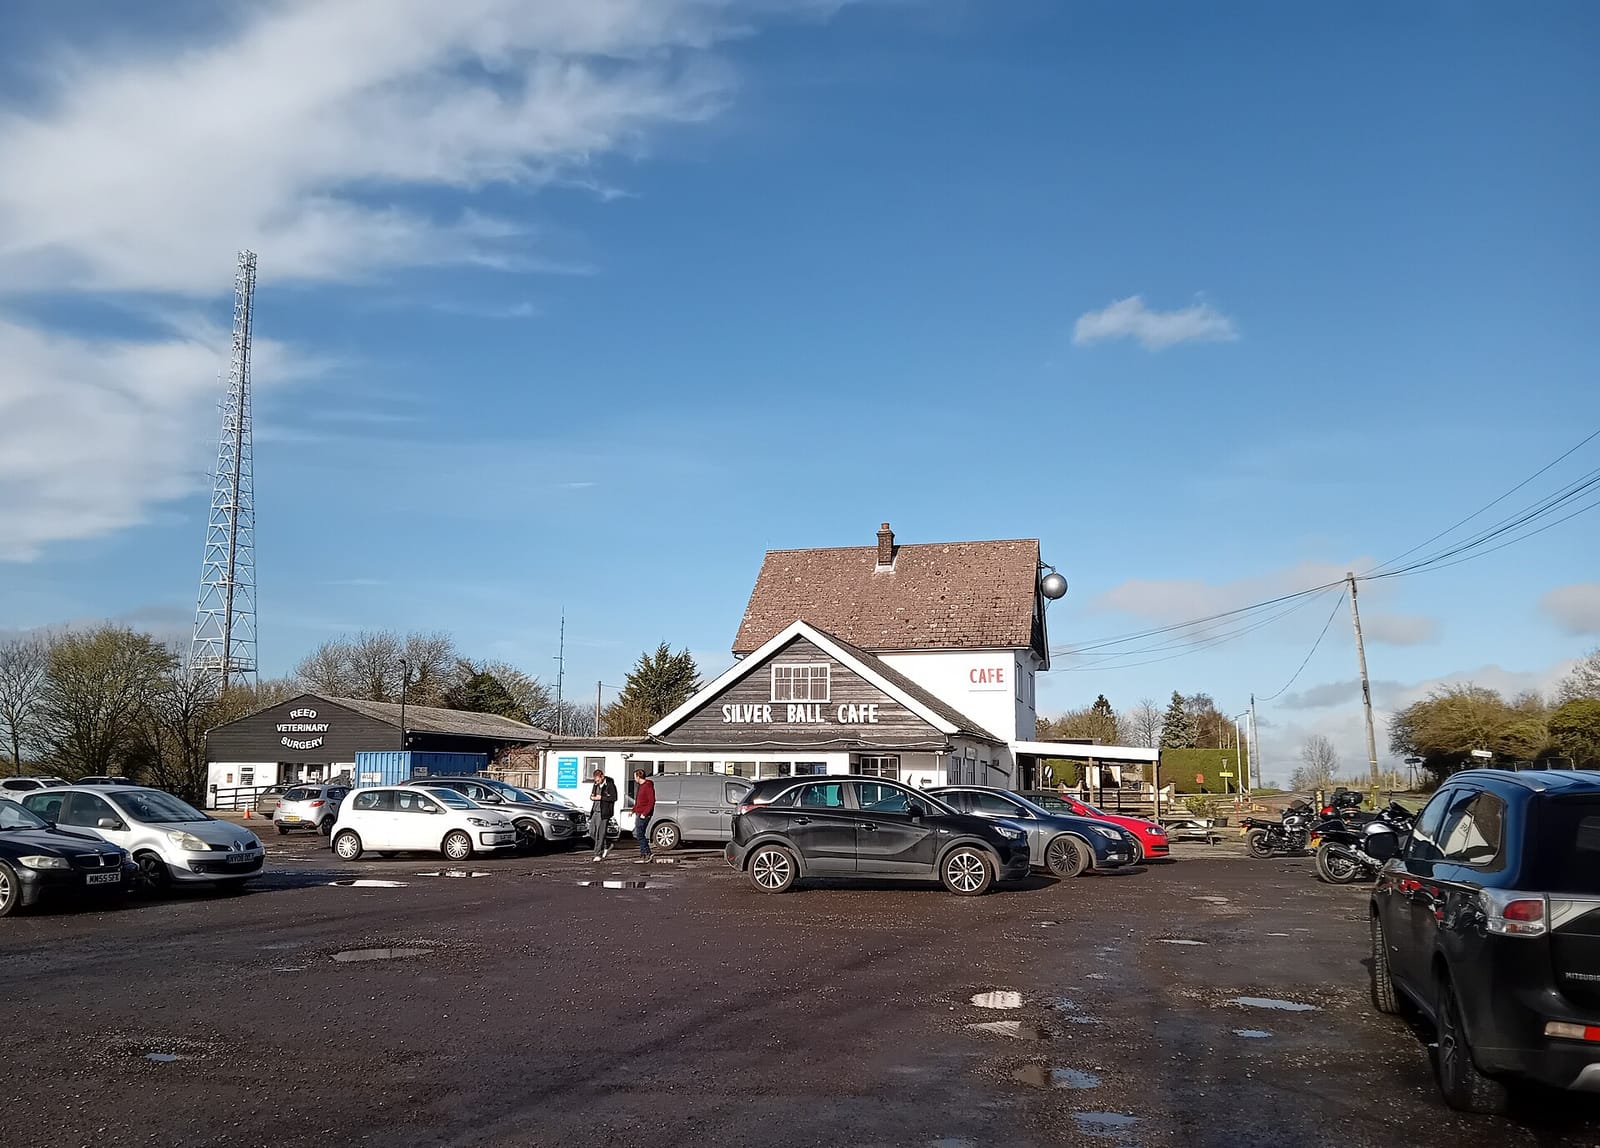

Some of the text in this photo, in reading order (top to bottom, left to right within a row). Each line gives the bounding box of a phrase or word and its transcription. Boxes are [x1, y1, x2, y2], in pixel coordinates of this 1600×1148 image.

[969, 668, 1004, 683] CAFE
[289, 708, 317, 719] REED
[787, 703, 825, 723] BALL
[837, 703, 879, 724] CAFE
[276, 723, 329, 732] VETERINARY
[280, 735, 323, 750] SURGERY
